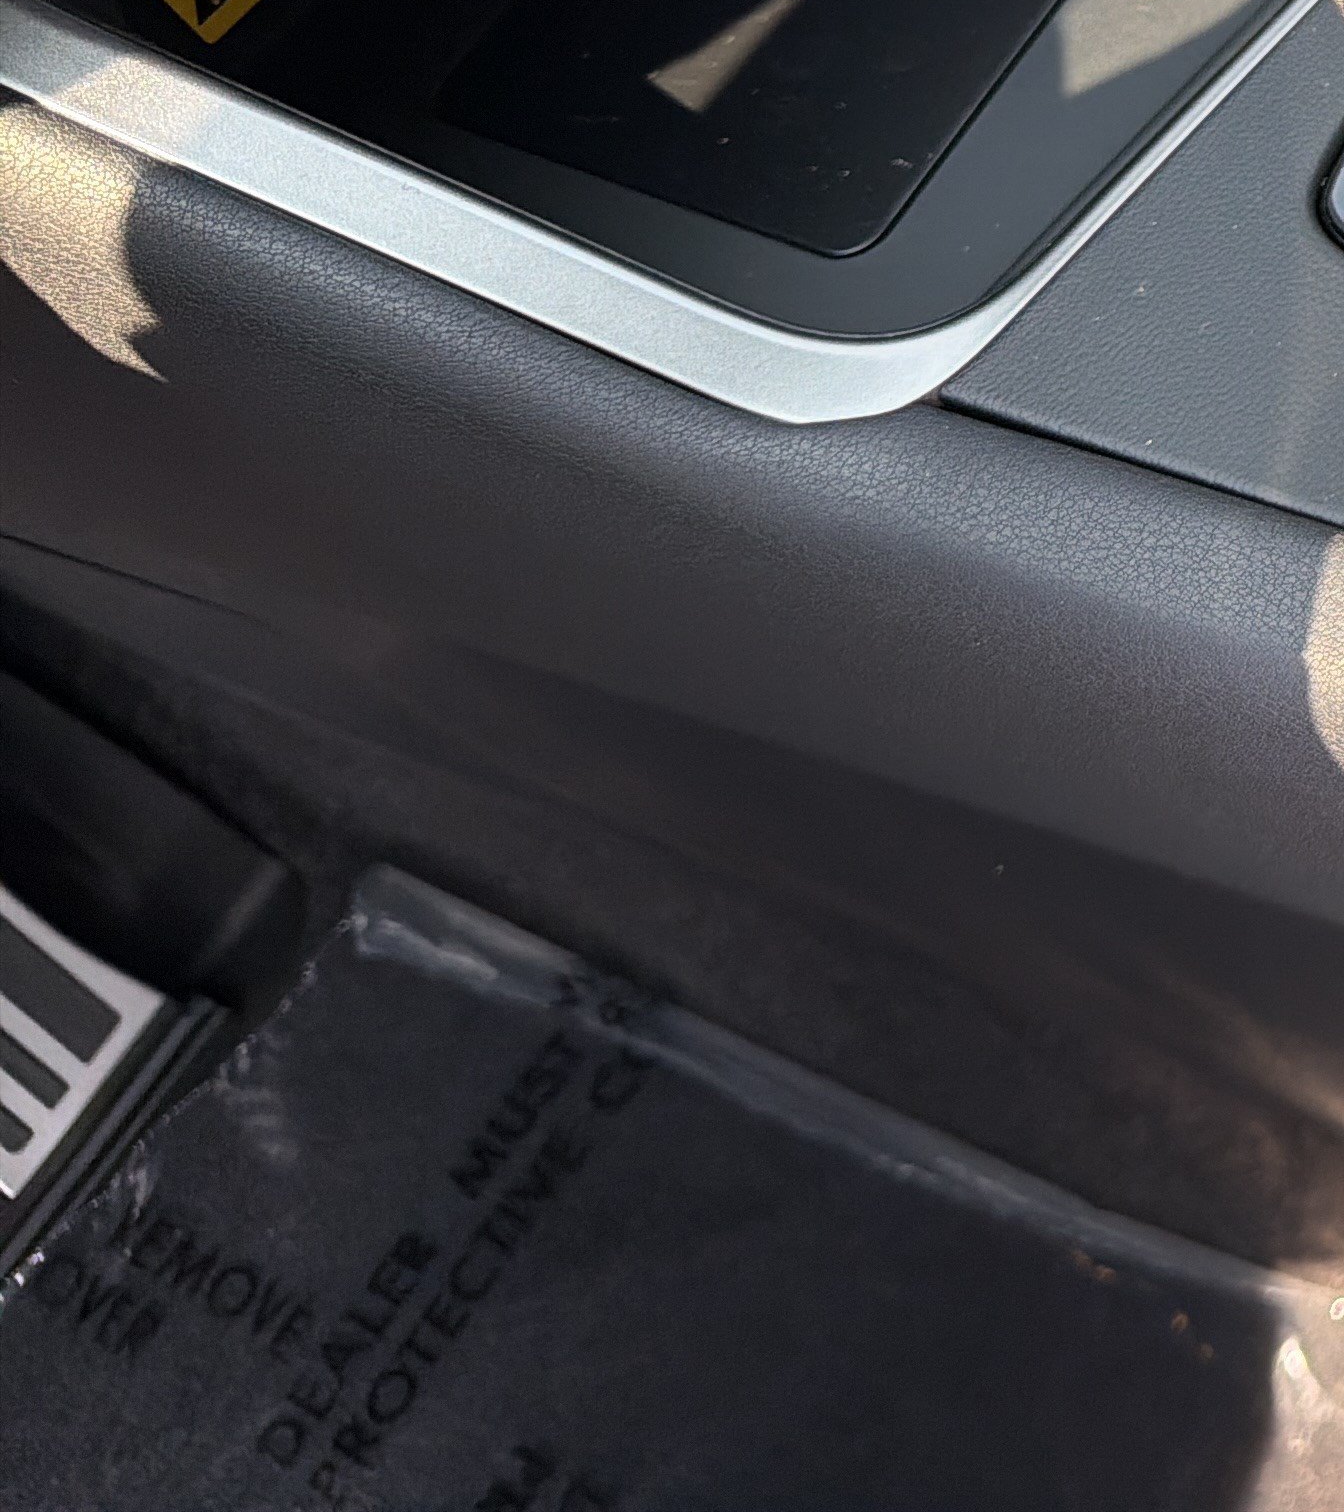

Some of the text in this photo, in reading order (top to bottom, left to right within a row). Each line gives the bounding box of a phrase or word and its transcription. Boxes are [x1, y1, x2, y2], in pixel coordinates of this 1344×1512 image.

[258, 1033, 580, 1466] DEALER MUST
[309, 1122, 594, 1506] PROTECTIVE
